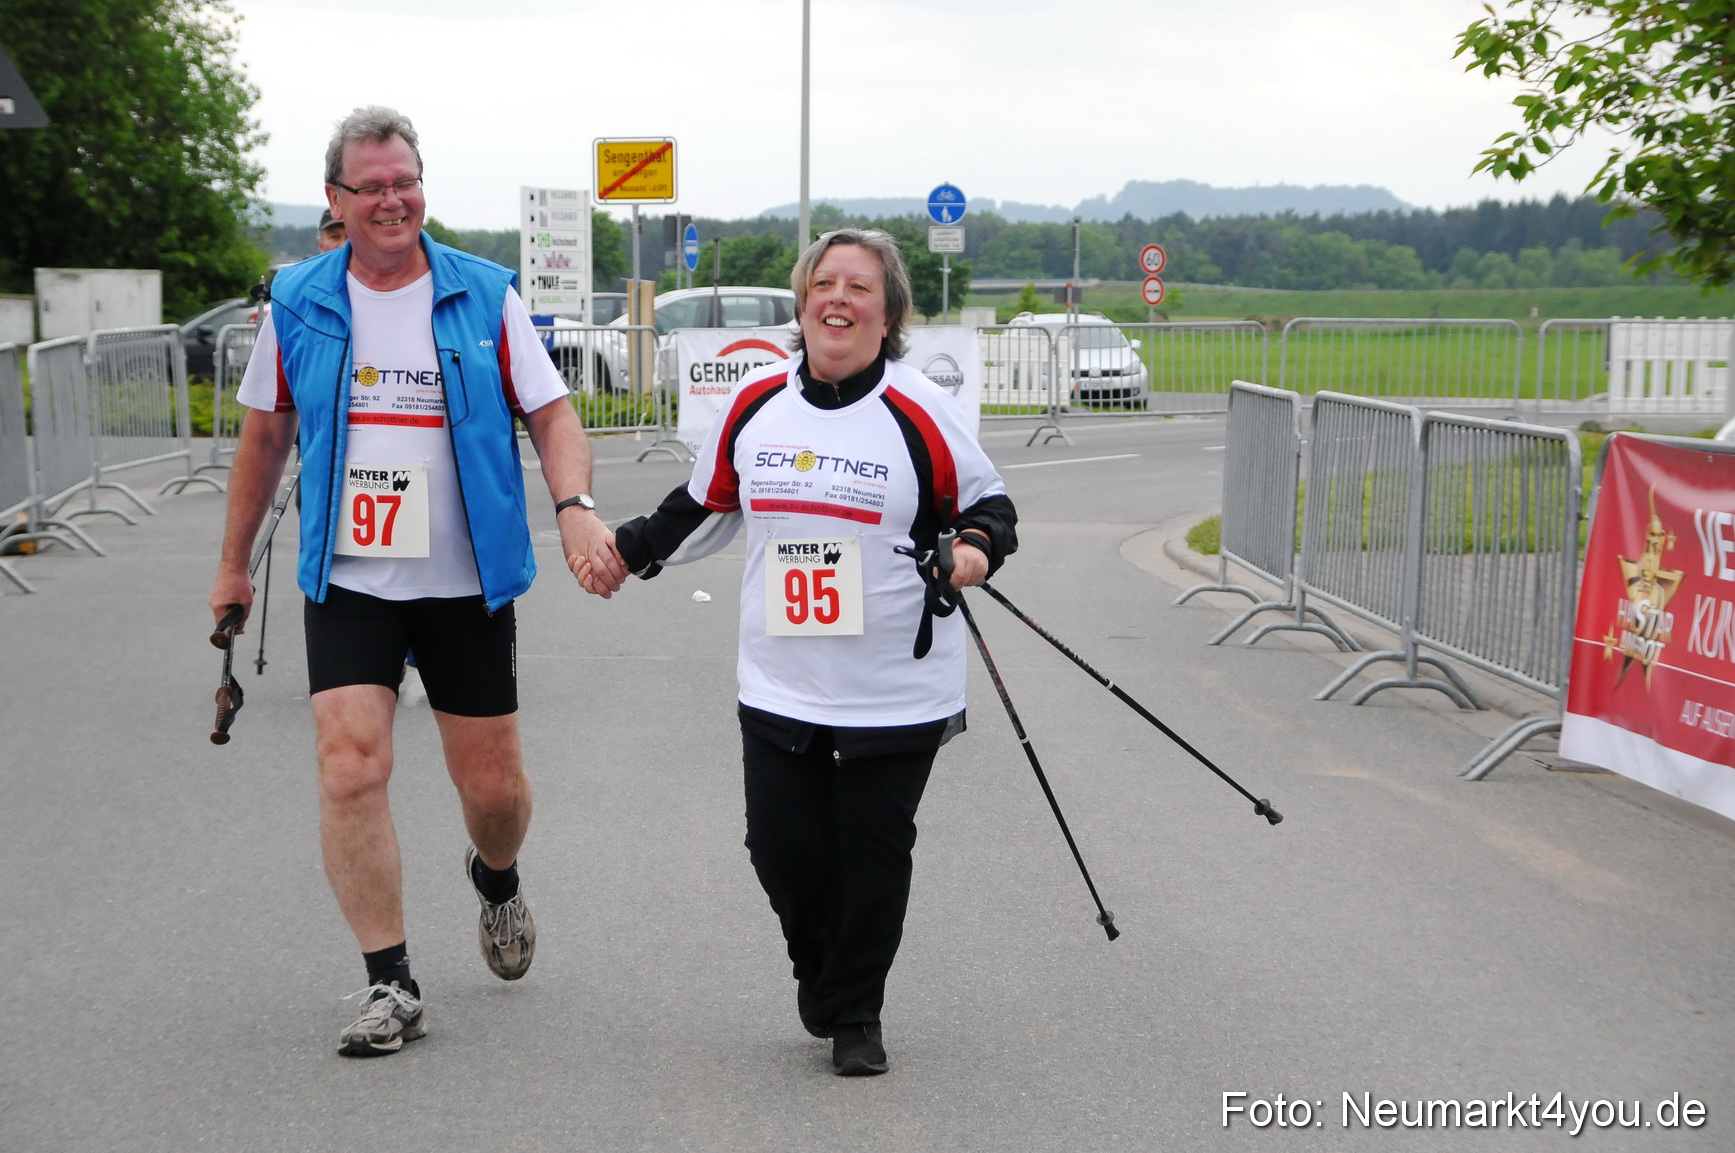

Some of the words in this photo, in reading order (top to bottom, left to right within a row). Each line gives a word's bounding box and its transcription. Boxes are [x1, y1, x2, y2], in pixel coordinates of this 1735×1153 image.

[603, 148, 667, 167] Sengenthal
[1146, 252, 1161, 266] 60
[690, 361, 776, 383] GERHA
[690, 385, 732, 395] Autohaus
[349, 468, 390, 481] MEYER
[348, 479, 390, 490] WERBUNG
[750, 480, 790, 488] Regensburger
[831, 484, 851, 493] 92318
[852, 488, 885, 500] Neumarkt
[825, 491, 838, 499] Fax
[839, 493, 884, 508] 09181/254803
[769, 503, 853, 517] www.sv-schottner.de
[352, 493, 402, 547] 97
[778, 543, 820, 555] MEYER
[1694, 508, 1735, 582] VE
[778, 554, 821, 564] WERBUNG
[784, 568, 840, 625] 95
